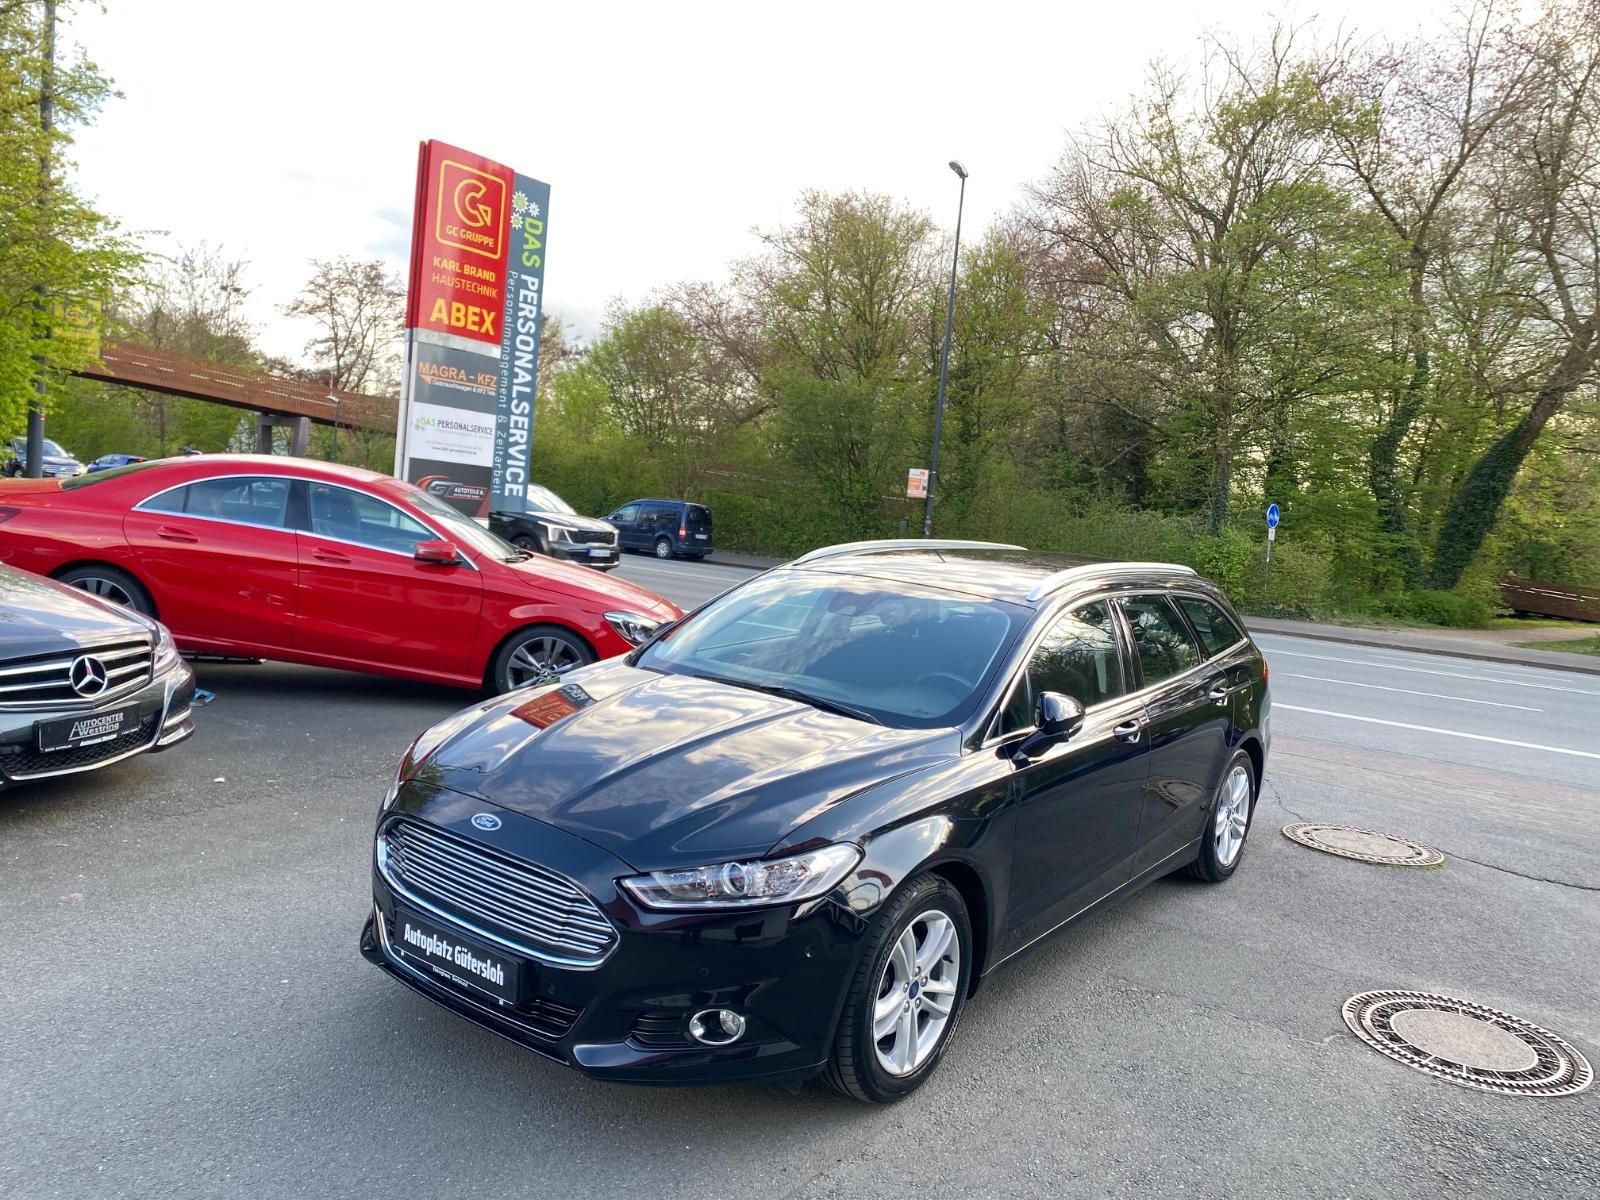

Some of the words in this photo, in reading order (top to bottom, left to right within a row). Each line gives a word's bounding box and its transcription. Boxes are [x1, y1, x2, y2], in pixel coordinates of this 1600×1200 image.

[446, 225, 459, 236] GC
[460, 229, 494, 248] GRUPPE
[521, 216, 544, 269] DAS
[433, 256, 461, 273] KARL
[463, 264, 496, 282] BRAND
[432, 273, 498, 299] HAUSTECHNIK
[430, 298, 496, 336] ABEX
[498, 270, 518, 408] Personalmanagement
[418, 362, 466, 381] MAGRA
[477, 372, 497, 387] KFZ
[504, 274, 539, 497] PERSONALSERVICE
[420, 417, 436, 426] DAS
[437, 420, 493, 436] PERSONALSERVICE
[491, 431, 507, 494] Zeitarbeit
[454, 487, 479, 495] AUTOTEILE
[69, 712, 124, 739] AUTOCENTER
[80, 722, 120, 736] Westring
[404, 923, 453, 961] Autoplatz
[454, 945, 504, 986] Gütersloh
